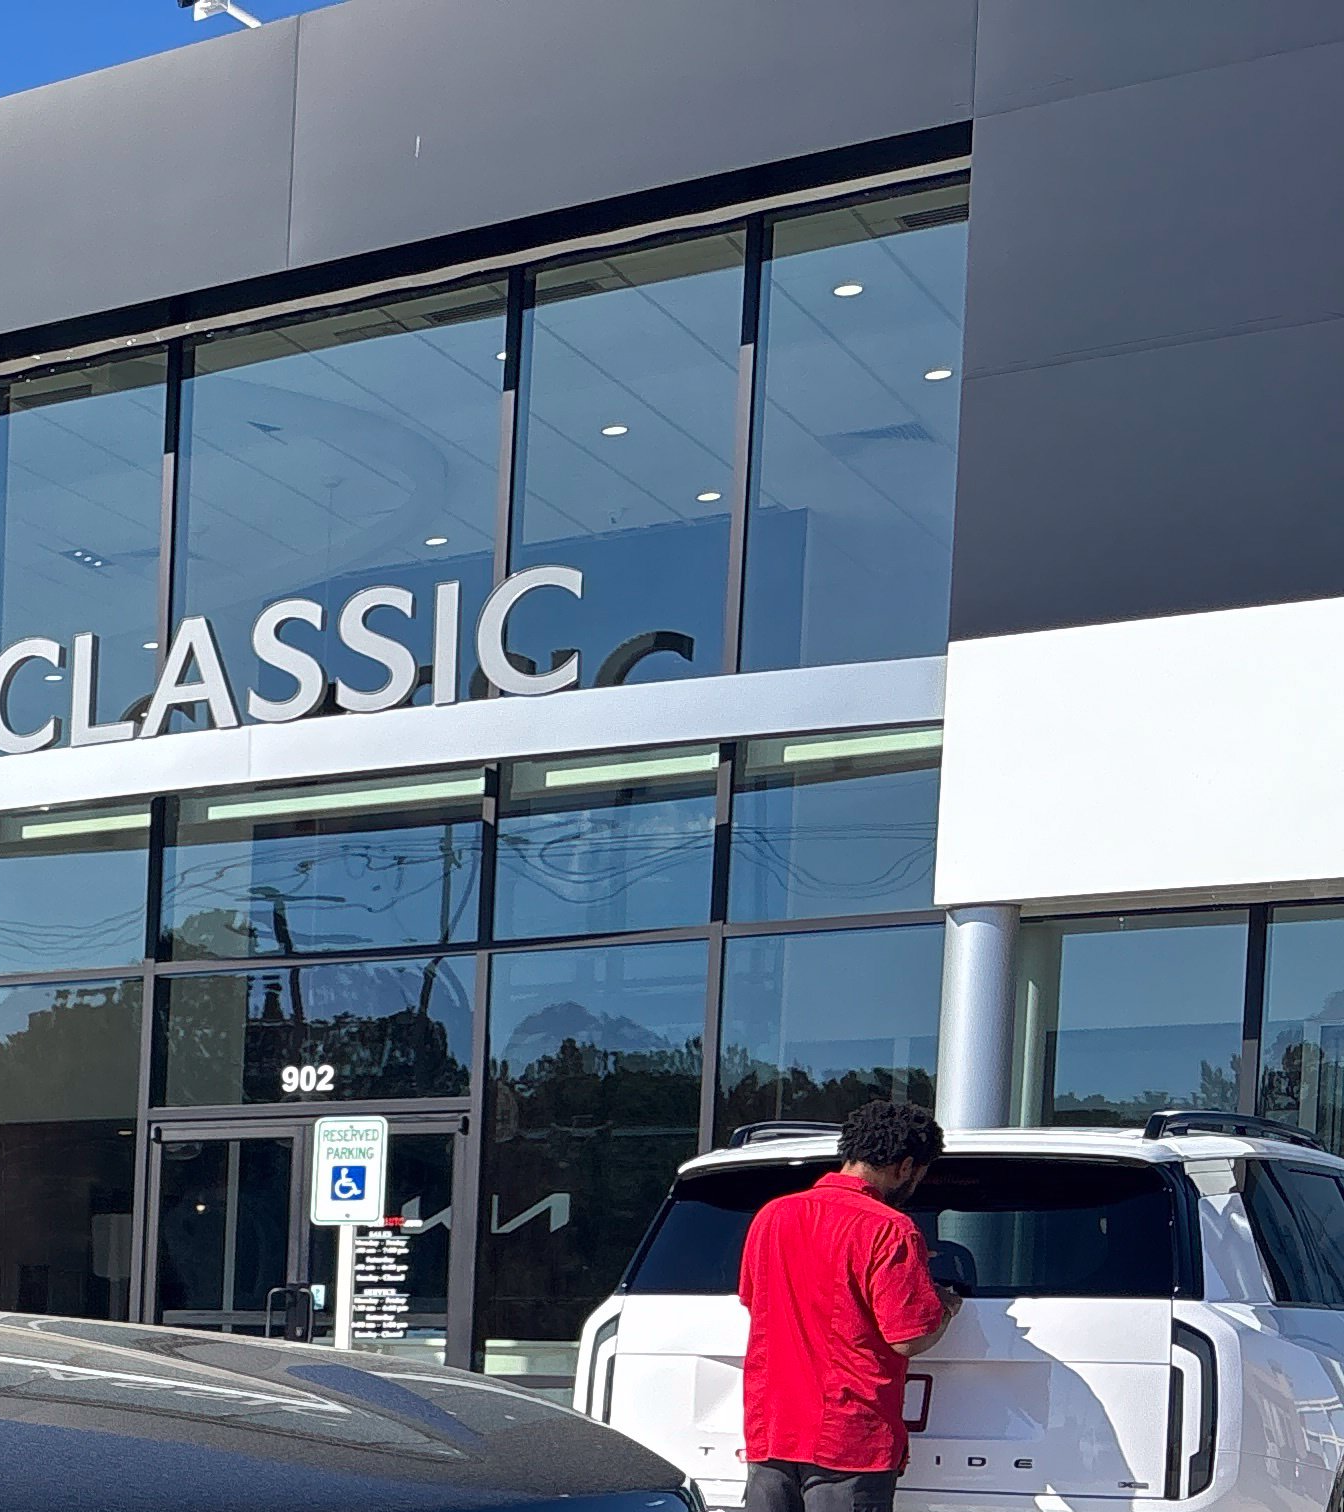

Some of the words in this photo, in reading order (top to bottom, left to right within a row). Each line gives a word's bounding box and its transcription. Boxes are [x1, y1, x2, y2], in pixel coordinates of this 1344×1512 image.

[281, 1064, 335, 1092] 902
[322, 1129, 380, 1142] RESERVED
[326, 1146, 375, 1160] PARKING
